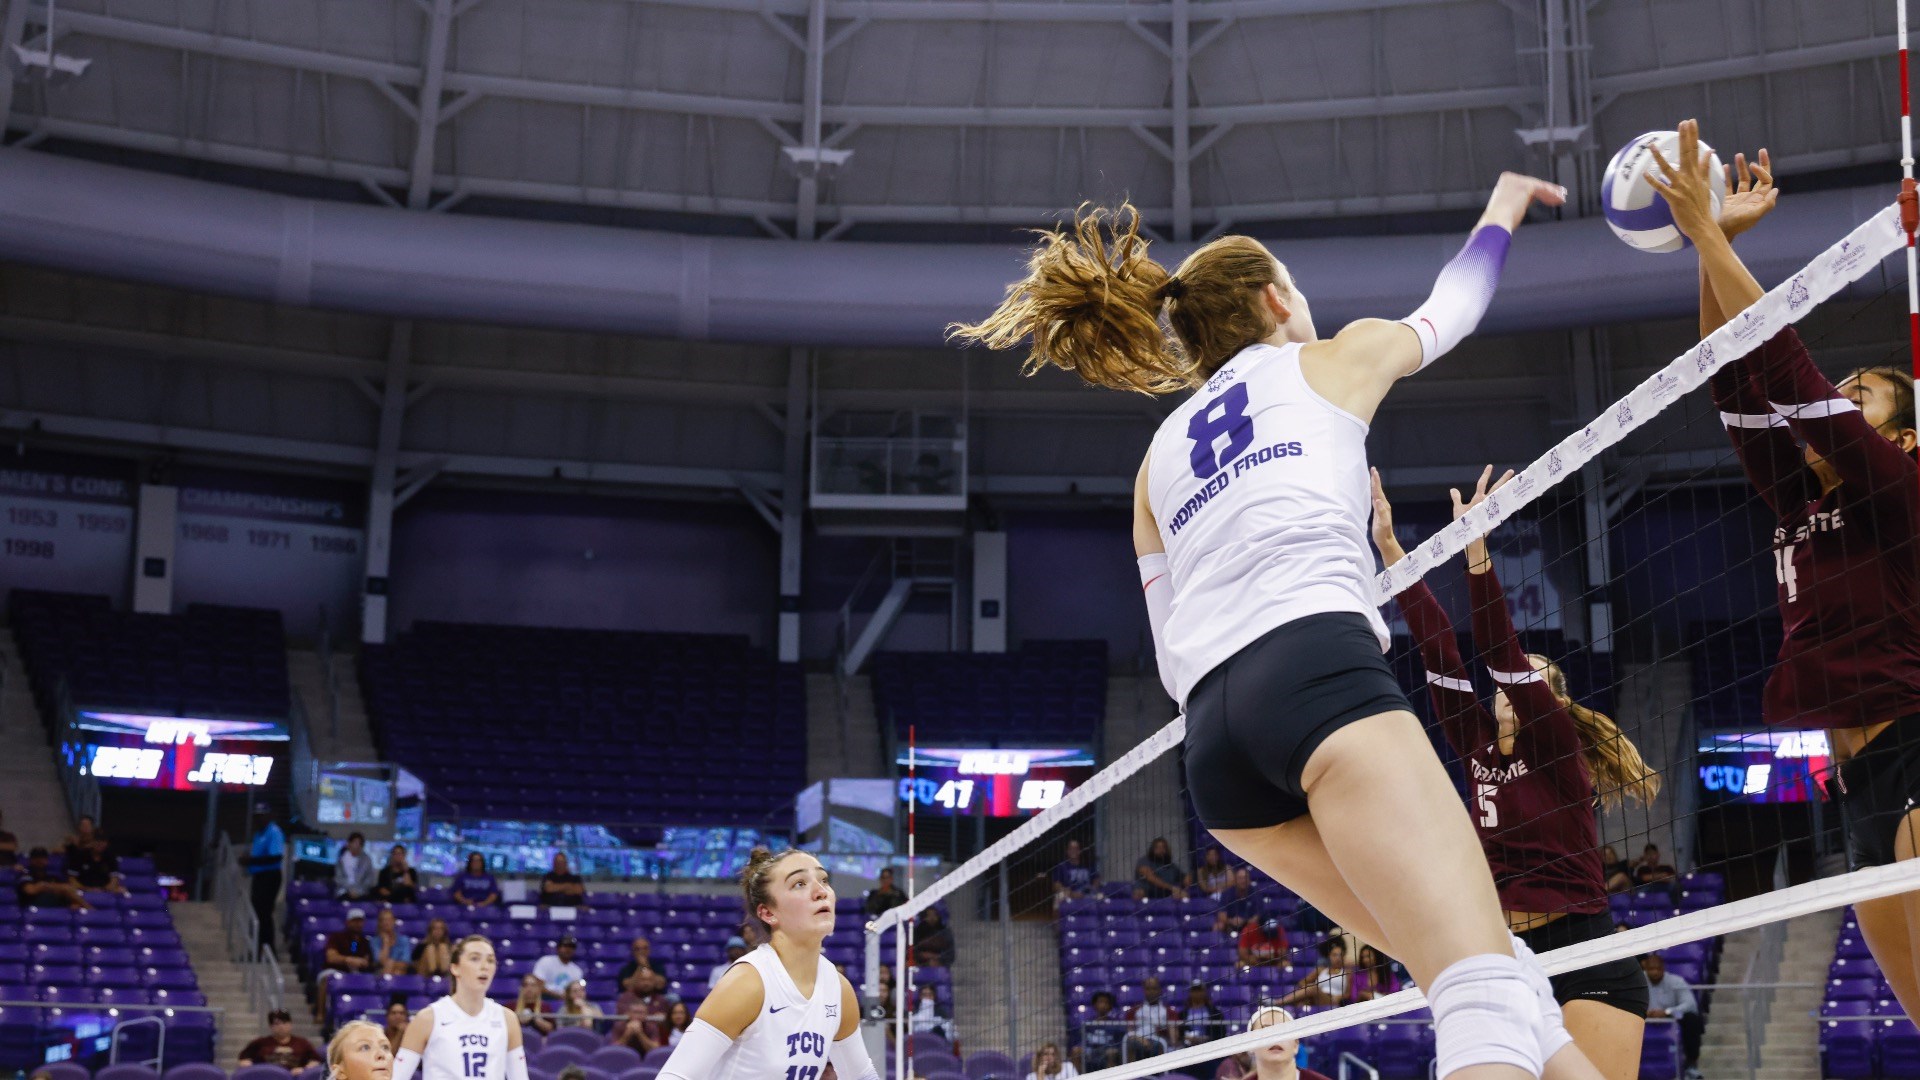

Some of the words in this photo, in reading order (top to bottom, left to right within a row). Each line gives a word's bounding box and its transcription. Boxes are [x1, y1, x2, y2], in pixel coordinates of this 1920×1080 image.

[1187, 382, 1254, 479] 8
[1169, 471, 1229, 536] HORNED
[1233, 441, 1303, 478] FROGS
[1794, 508, 1845, 542] SATE
[4, 537, 55, 559] 1998
[248, 529, 291, 549] 1971
[1478, 784, 1498, 827] 5
[459, 1034, 488, 1047] TCU
[786, 1031, 824, 1058] TCU
[462, 1052, 487, 1077] 12
